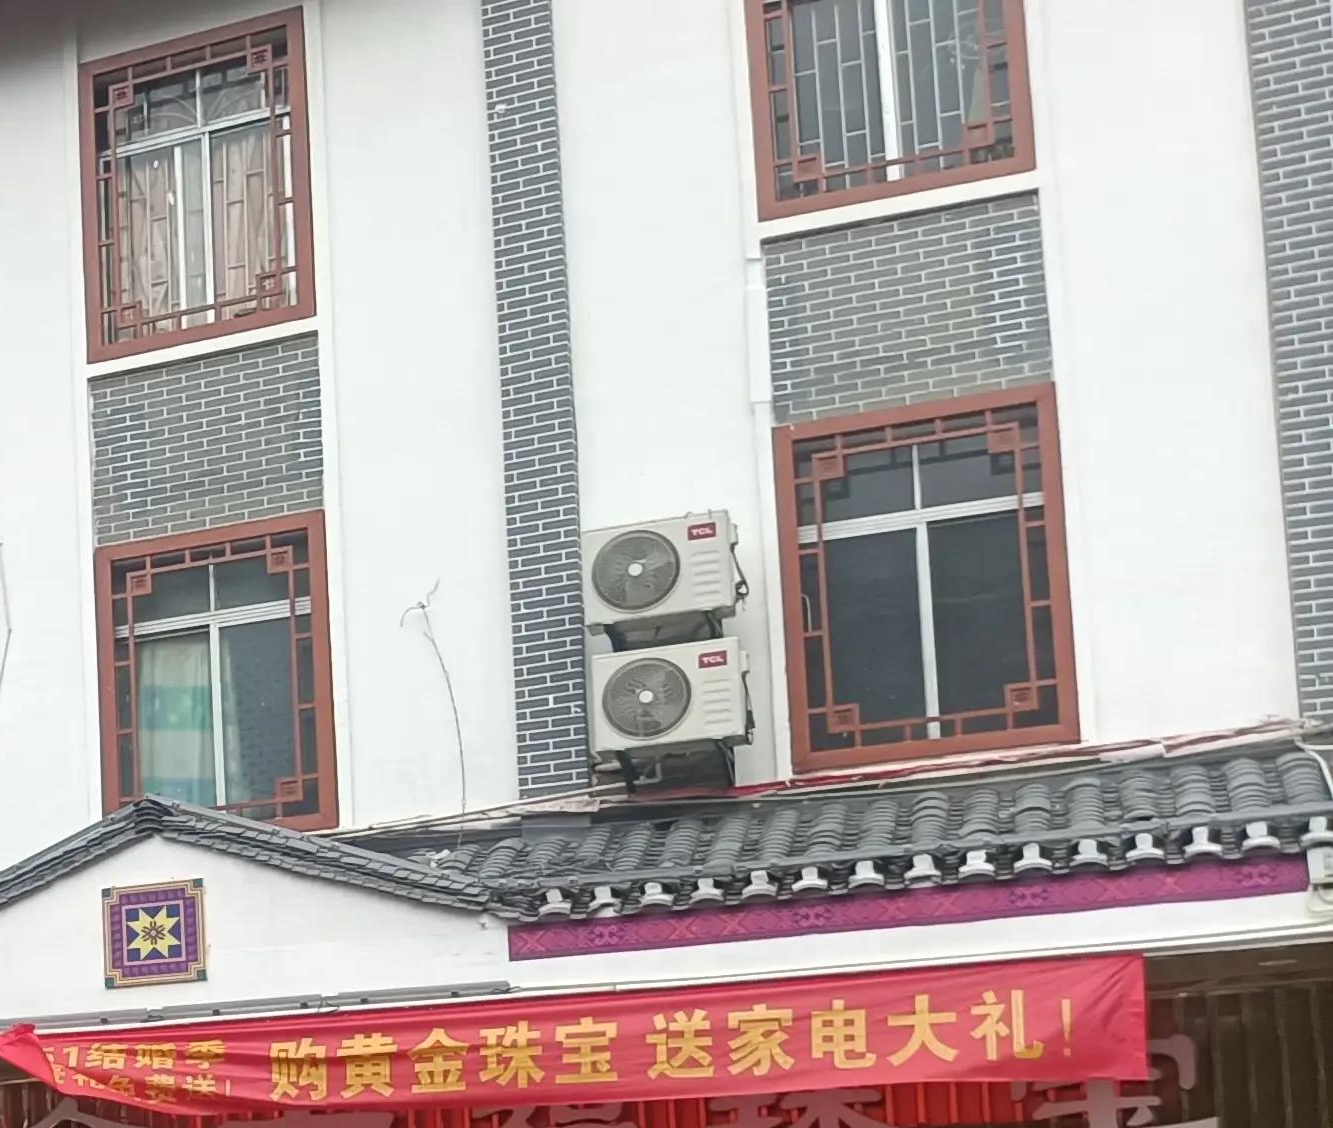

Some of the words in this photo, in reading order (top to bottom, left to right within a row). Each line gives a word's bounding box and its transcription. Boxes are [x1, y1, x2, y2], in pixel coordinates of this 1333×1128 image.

[691, 527, 714, 537] TCL
[702, 655, 724, 664] TCL
[269, 1018, 618, 1102] 购黄金珠宝
